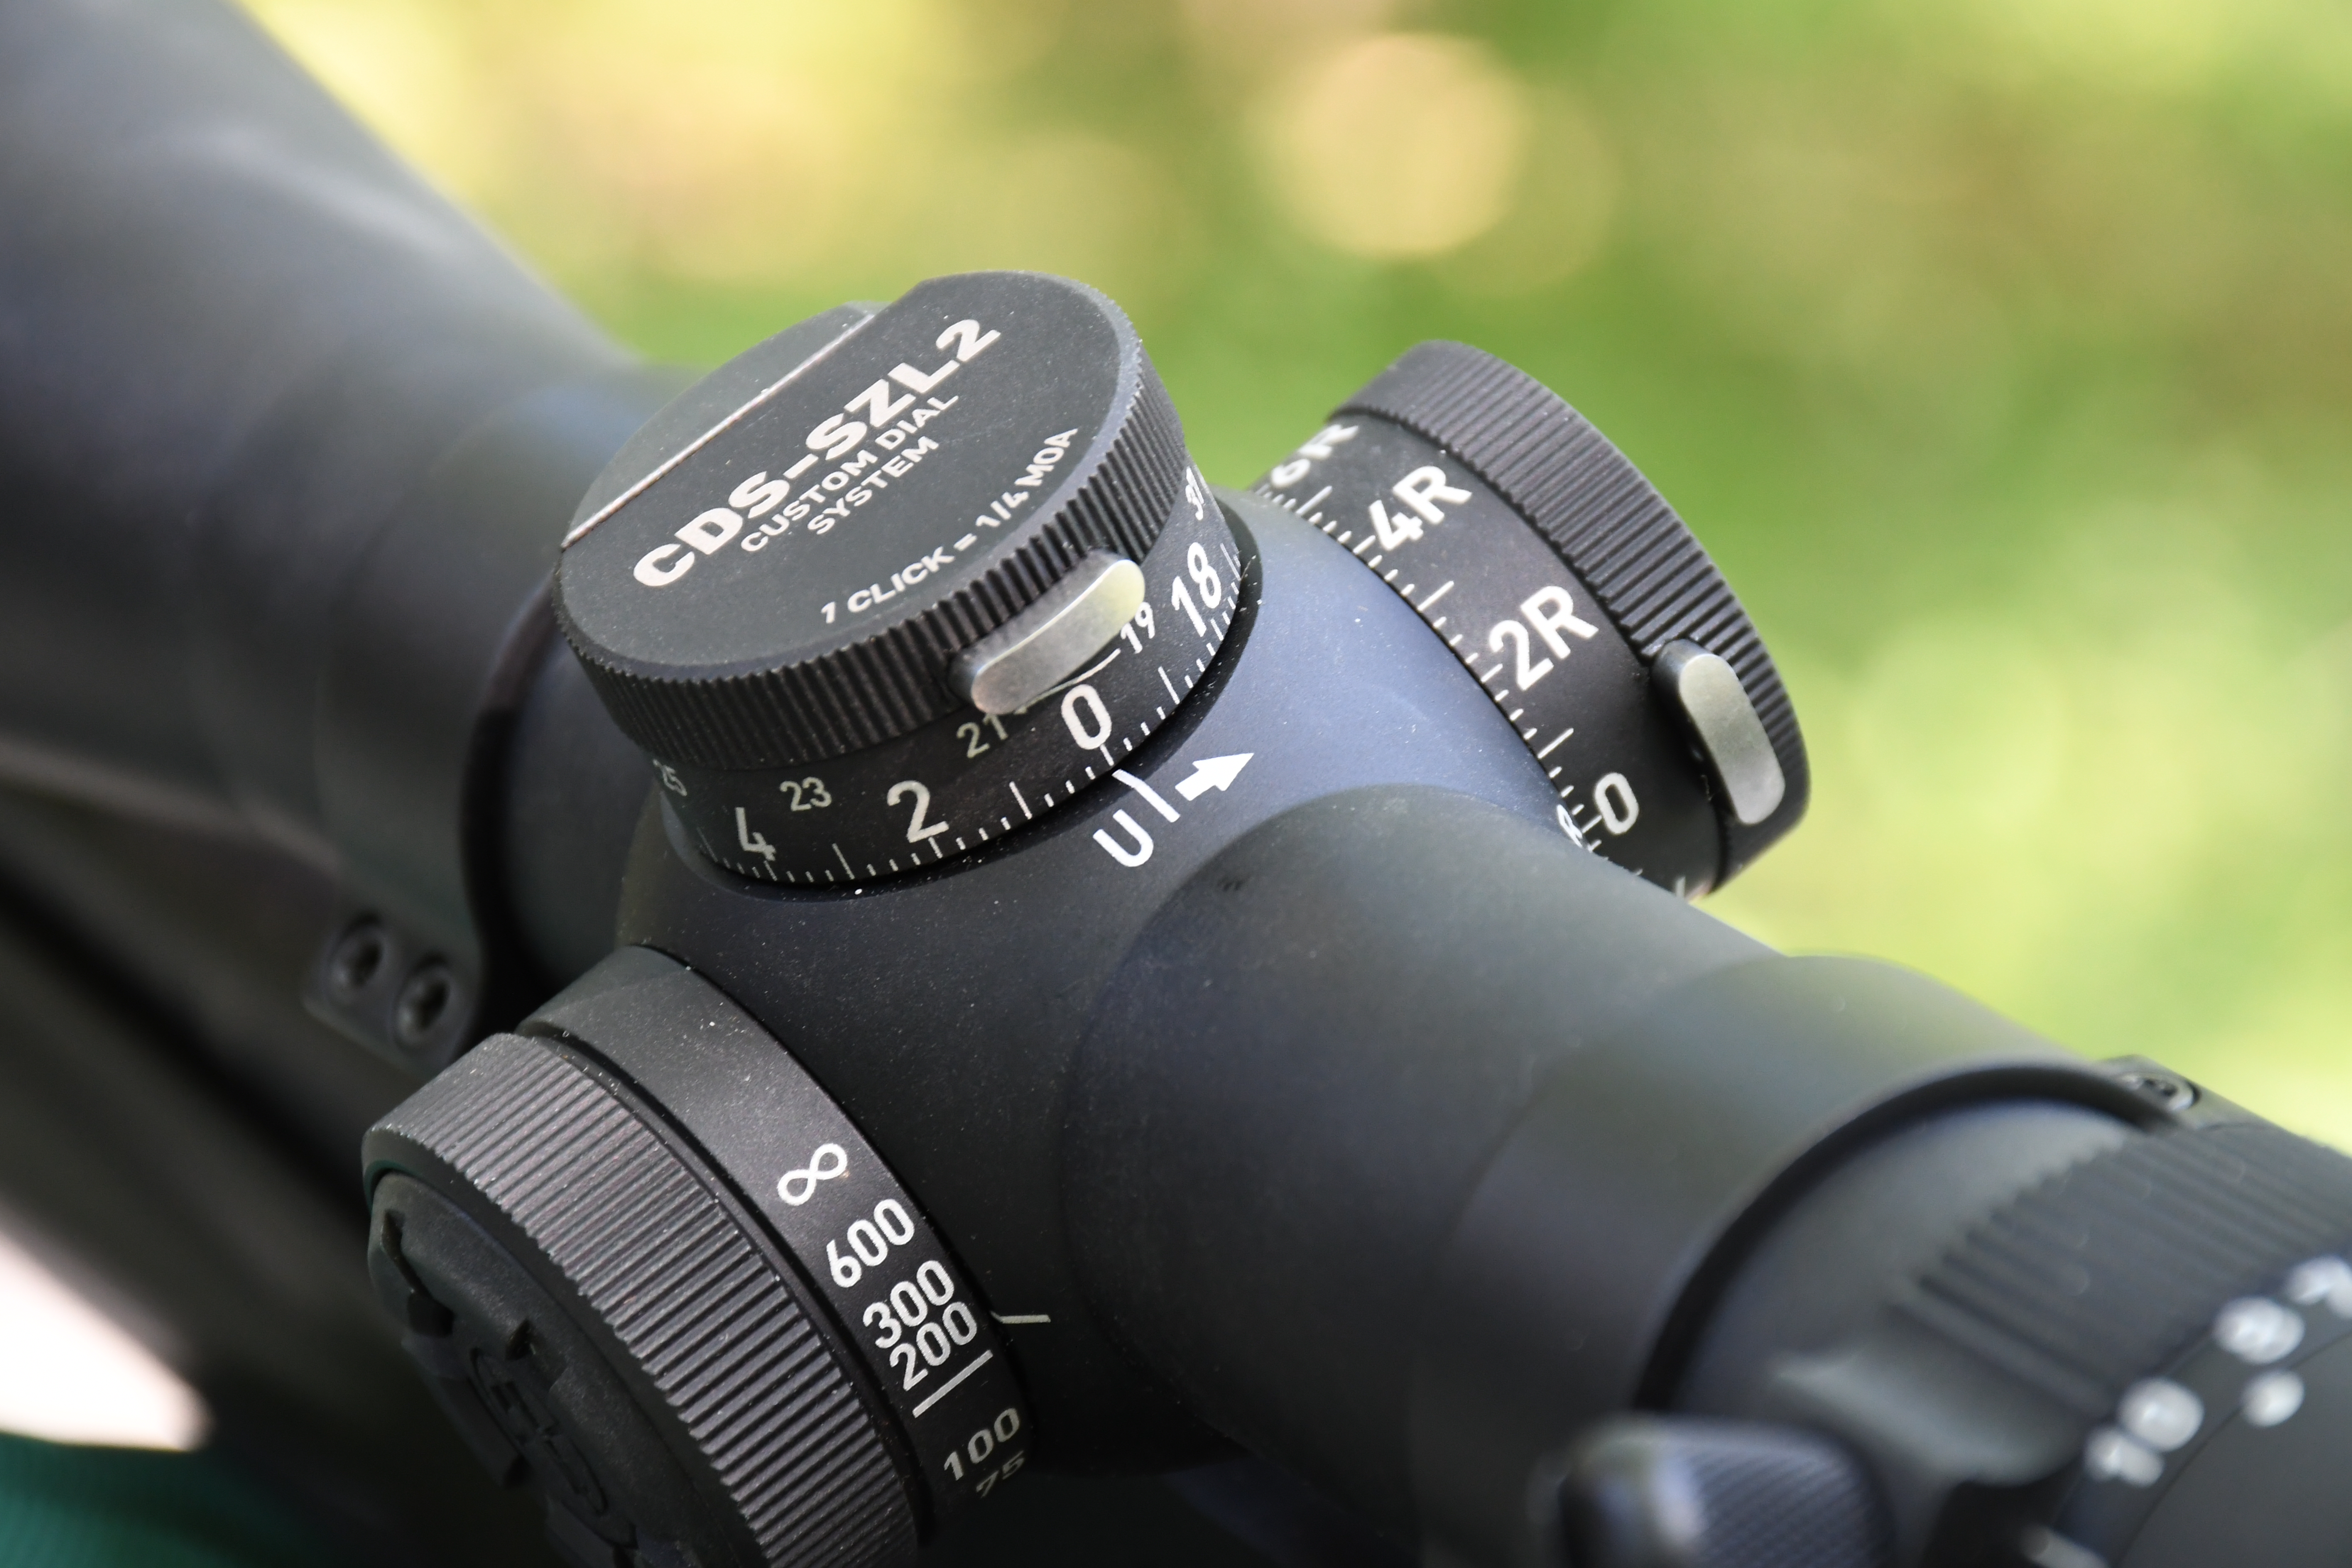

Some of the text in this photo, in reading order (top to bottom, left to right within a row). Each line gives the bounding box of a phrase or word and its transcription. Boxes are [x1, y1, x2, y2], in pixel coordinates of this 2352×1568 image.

[632, 318, 1002, 588] CDS-SZL2
[740, 395, 959, 553] CUSTOM DIAL
[807, 436, 939, 535] SYSTEM
[1270, 424, 1358, 487] 6R
[820, 428, 1079, 624] 1 CLICK = 1/4 MOA
[1367, 464, 1473, 553] 4R
[1171, 541, 1222, 637] 18
[1120, 601, 1156, 654] 19
[1489, 585, 1598, 691] 2R
[957, 713, 1007, 758] 21
[1060, 683, 1113, 750] 0
[780, 776, 832, 811] 23
[887, 780, 950, 844] 2
[1593, 772, 1639, 835] 0
[735, 806, 776, 861] 4
[1092, 808, 1154, 868] U
[825, 1198, 915, 1288] 600
[863, 1260, 955, 1349] 300
[889, 1301, 977, 1391] 200
[943, 1408, 1020, 1481] 100
[975, 1450, 1025, 1499] 75
